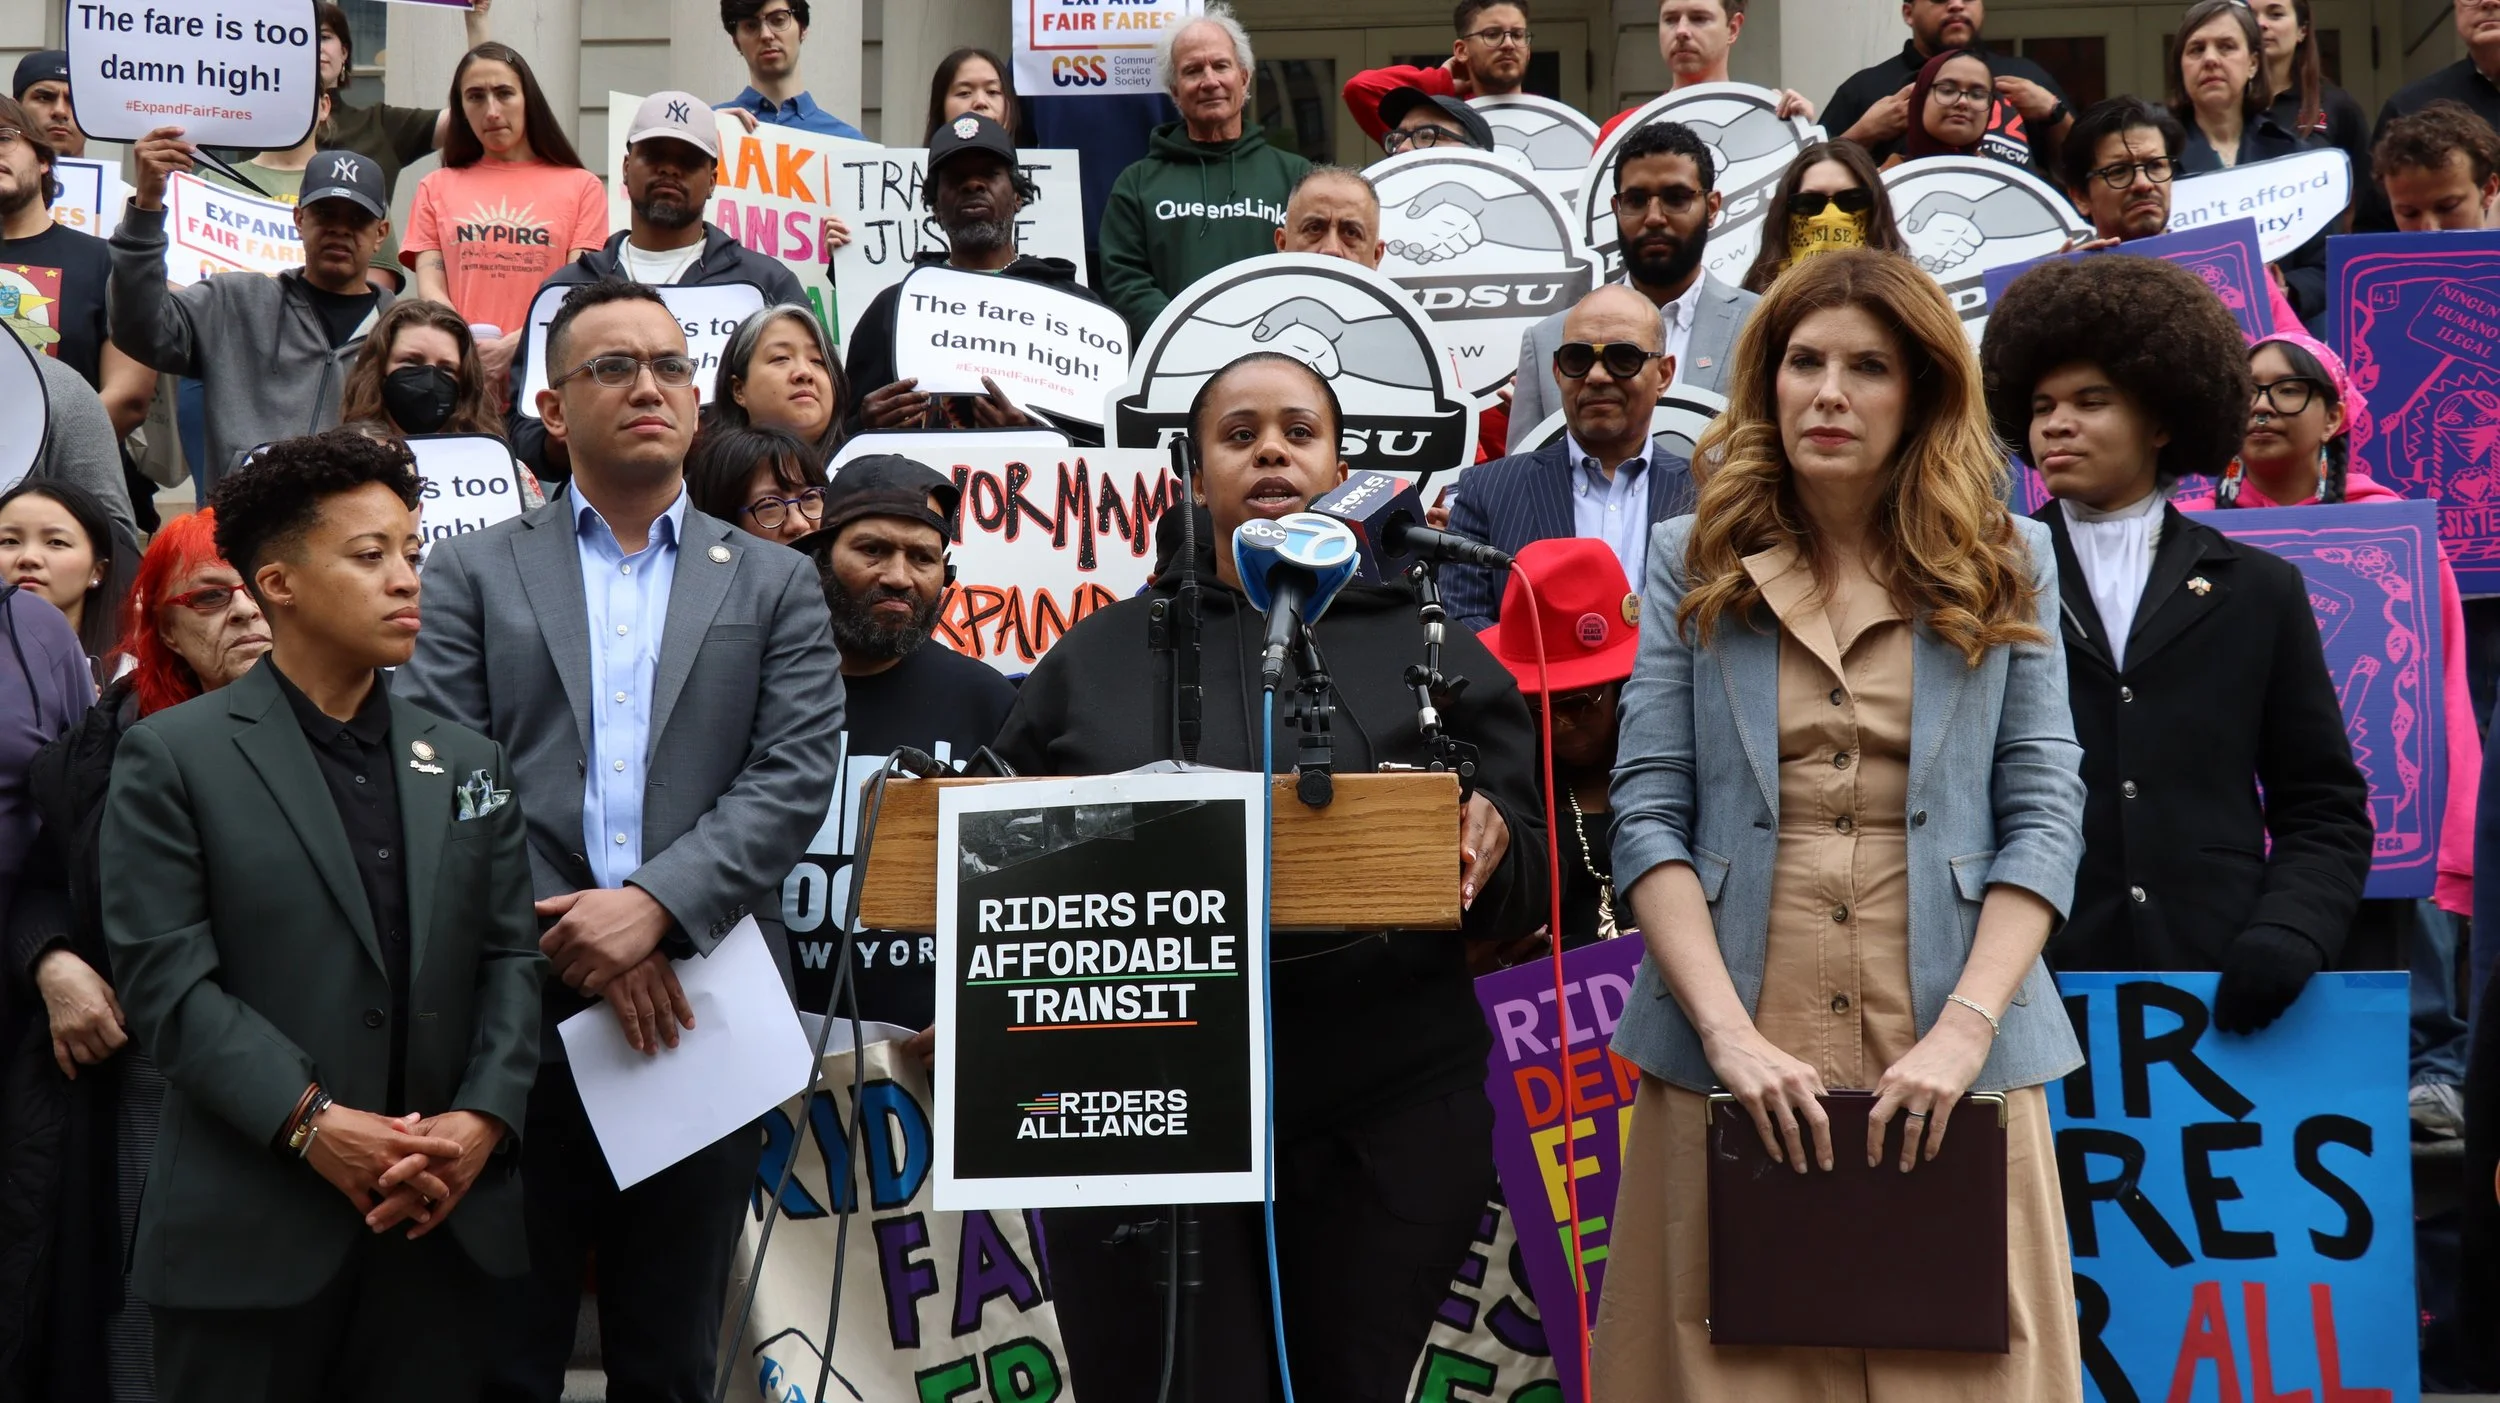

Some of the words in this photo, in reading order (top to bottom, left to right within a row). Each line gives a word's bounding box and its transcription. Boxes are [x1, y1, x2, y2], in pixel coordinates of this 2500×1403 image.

[78, 4, 134, 33] The
[144, 8, 204, 37] fare
[216, 13, 243, 40] is
[254, 19, 309, 47] too
[1043, 13, 1096, 31] FAIR
[101, 54, 185, 84] damn
[197, 60, 281, 96] high!
[1052, 55, 1107, 87] CSS
[1114, 66, 1151, 75] Service
[1114, 77, 1151, 87] Society
[126, 101, 253, 121] #ExpandFairFares
[1992, 143, 2029, 164] UFCW
[1155, 198, 1287, 225] QueensLink
[2167, 200, 2229, 229] an't
[2239, 171, 2329, 212] afford
[188, 216, 240, 252] FAIR
[457, 223, 550, 246] NYPIRG
[910, 293, 967, 316] The
[977, 300, 1035, 326] fare
[1045, 313, 1069, 337] is
[1078, 326, 1123, 355] too
[930, 329, 1016, 357] damn
[1027, 342, 1099, 382] high!
[2436, 326, 2493, 359] ILEGAL
[955, 361, 1075, 396] #ExpandFairFares
[451, 476, 509, 498] too
[1240, 523, 1288, 541] abc
[979, 892, 1137, 933] RIDERS
[1146, 889, 1227, 926] FOR
[967, 935, 1237, 981] AFFORDABLE
[1008, 983, 1196, 1024] TRANSIT
[1060, 1089, 1187, 1115] RIDERS
[1016, 1113, 1188, 1140] ALLIANCE
[2163, 1281, 2393, 1403] ALL
